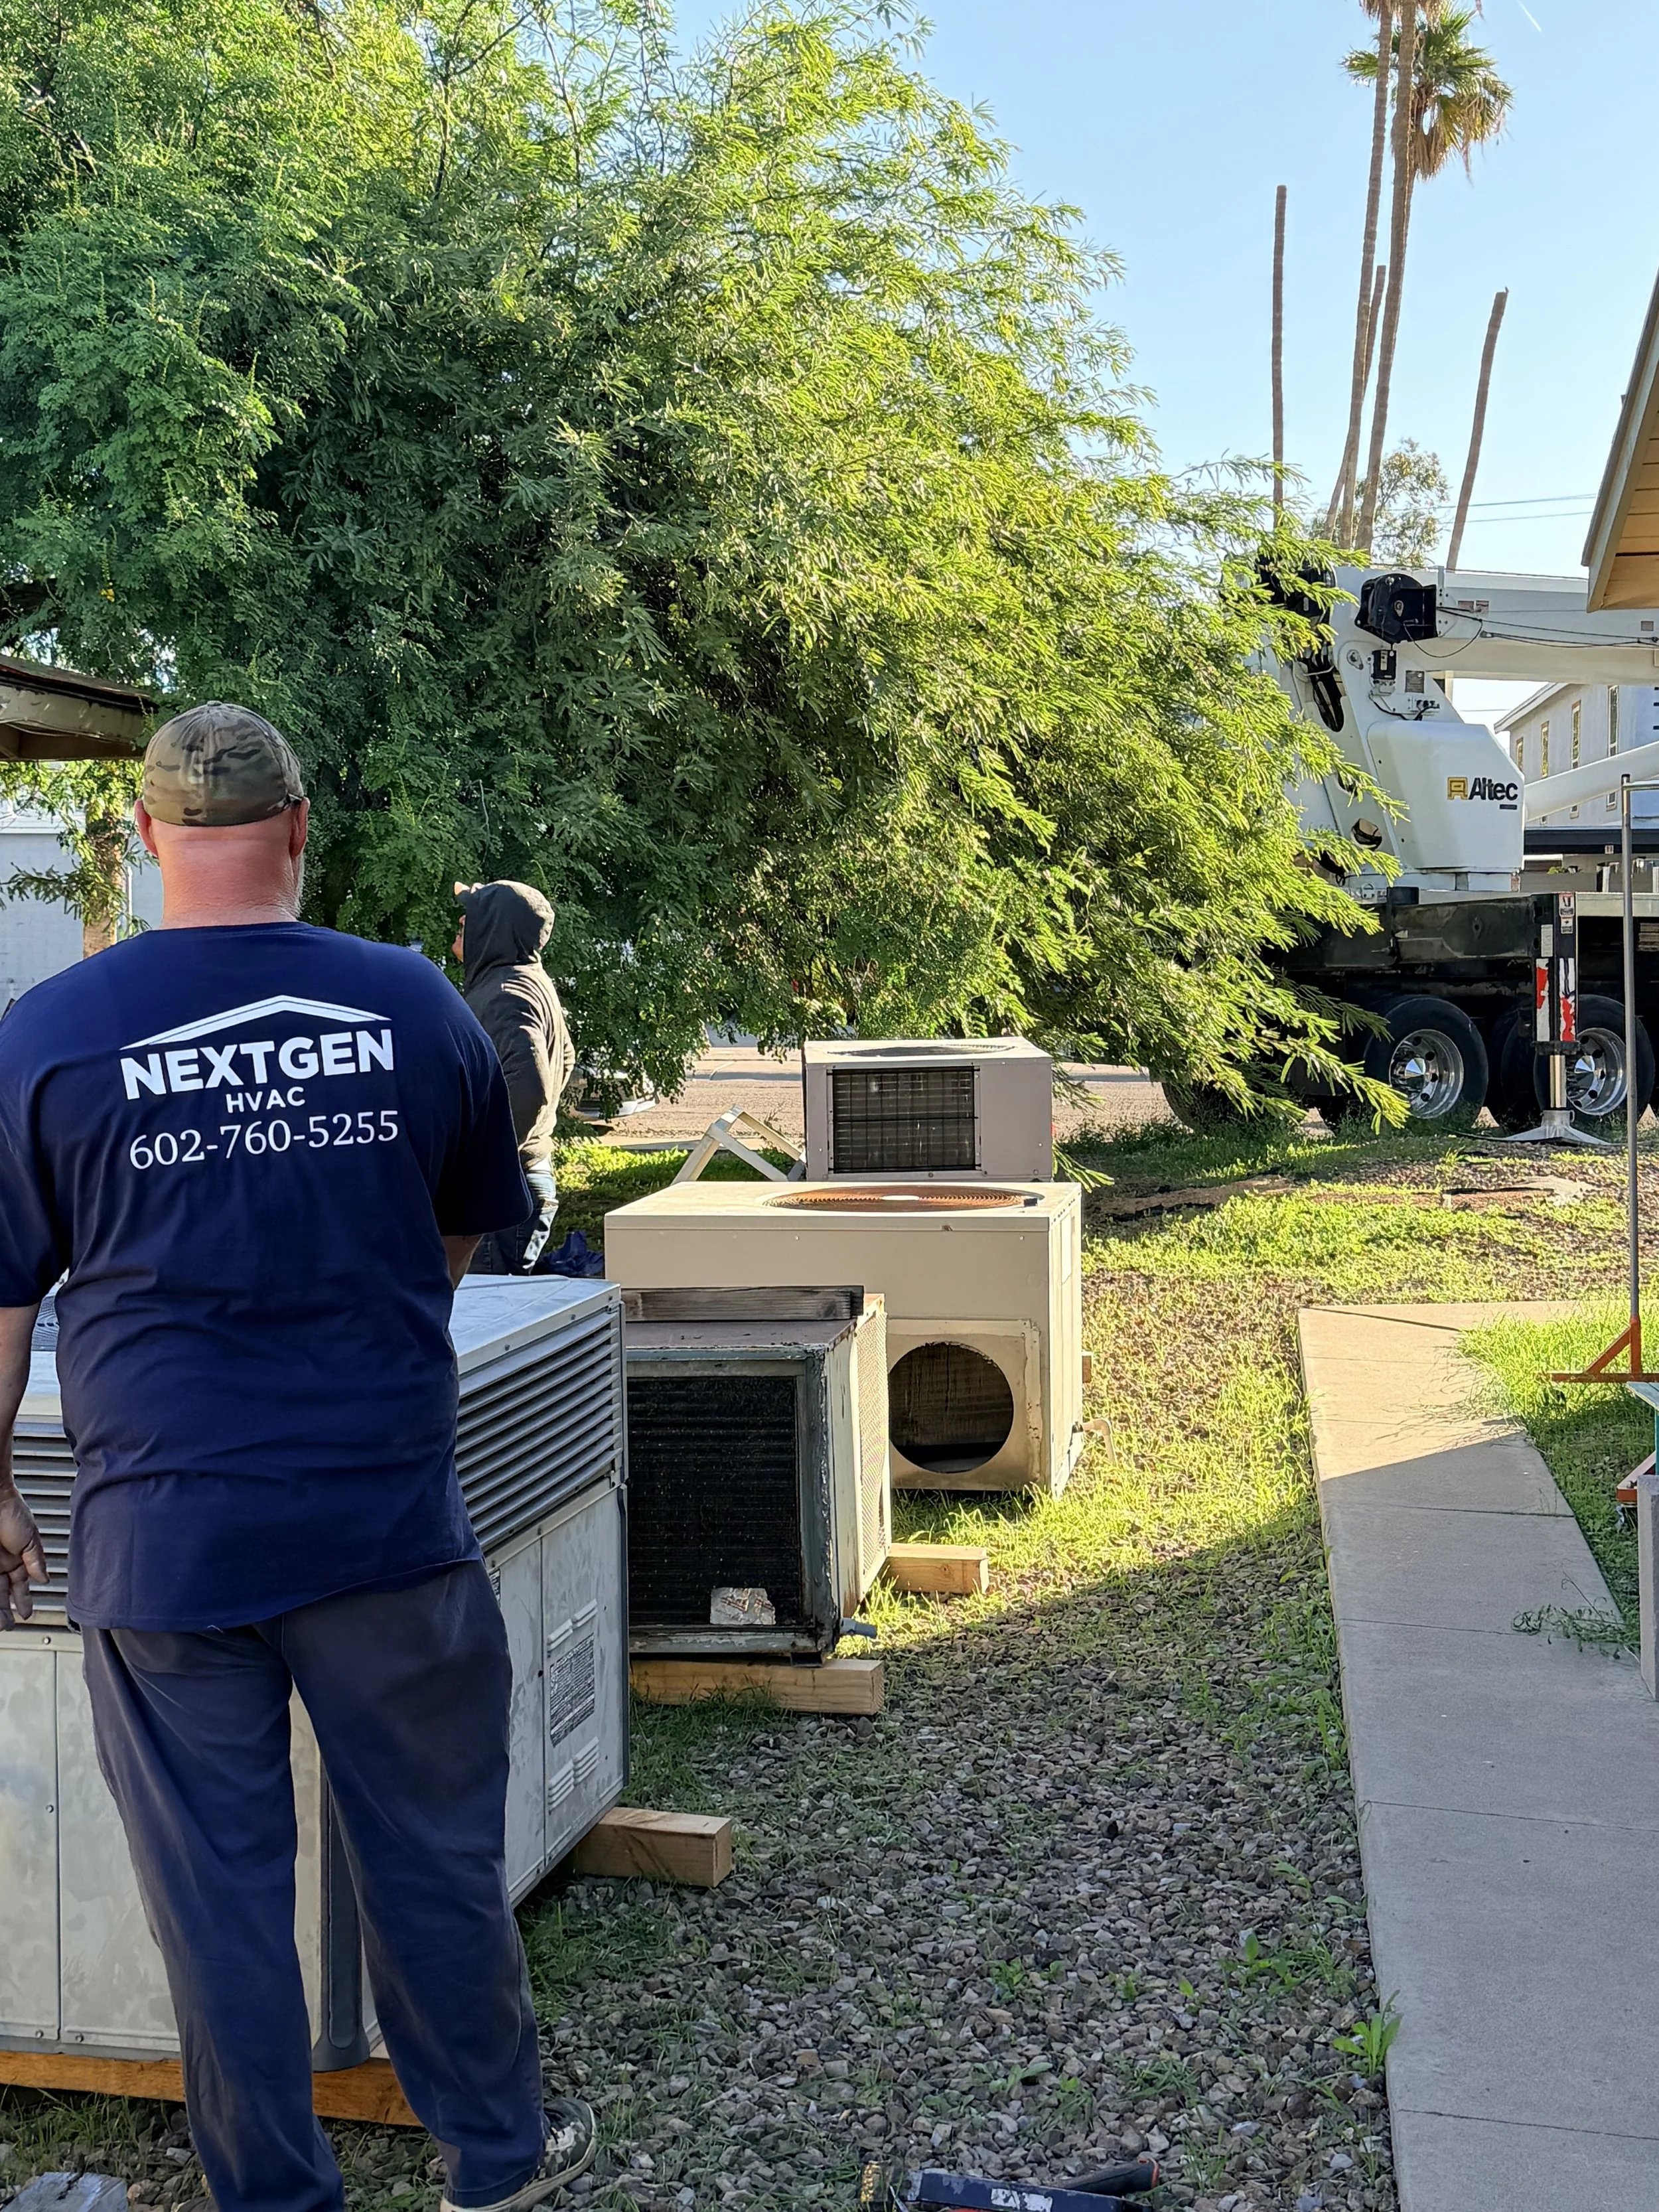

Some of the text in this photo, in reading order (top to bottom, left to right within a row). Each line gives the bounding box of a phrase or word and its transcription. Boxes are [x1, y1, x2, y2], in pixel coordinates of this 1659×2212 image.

[1468, 777, 1518, 800] Altec
[119, 1029, 394, 1100] NEXTGEN
[226, 1086, 306, 1114] HVAC
[129, 1110, 399, 1169] 602-760-5255
